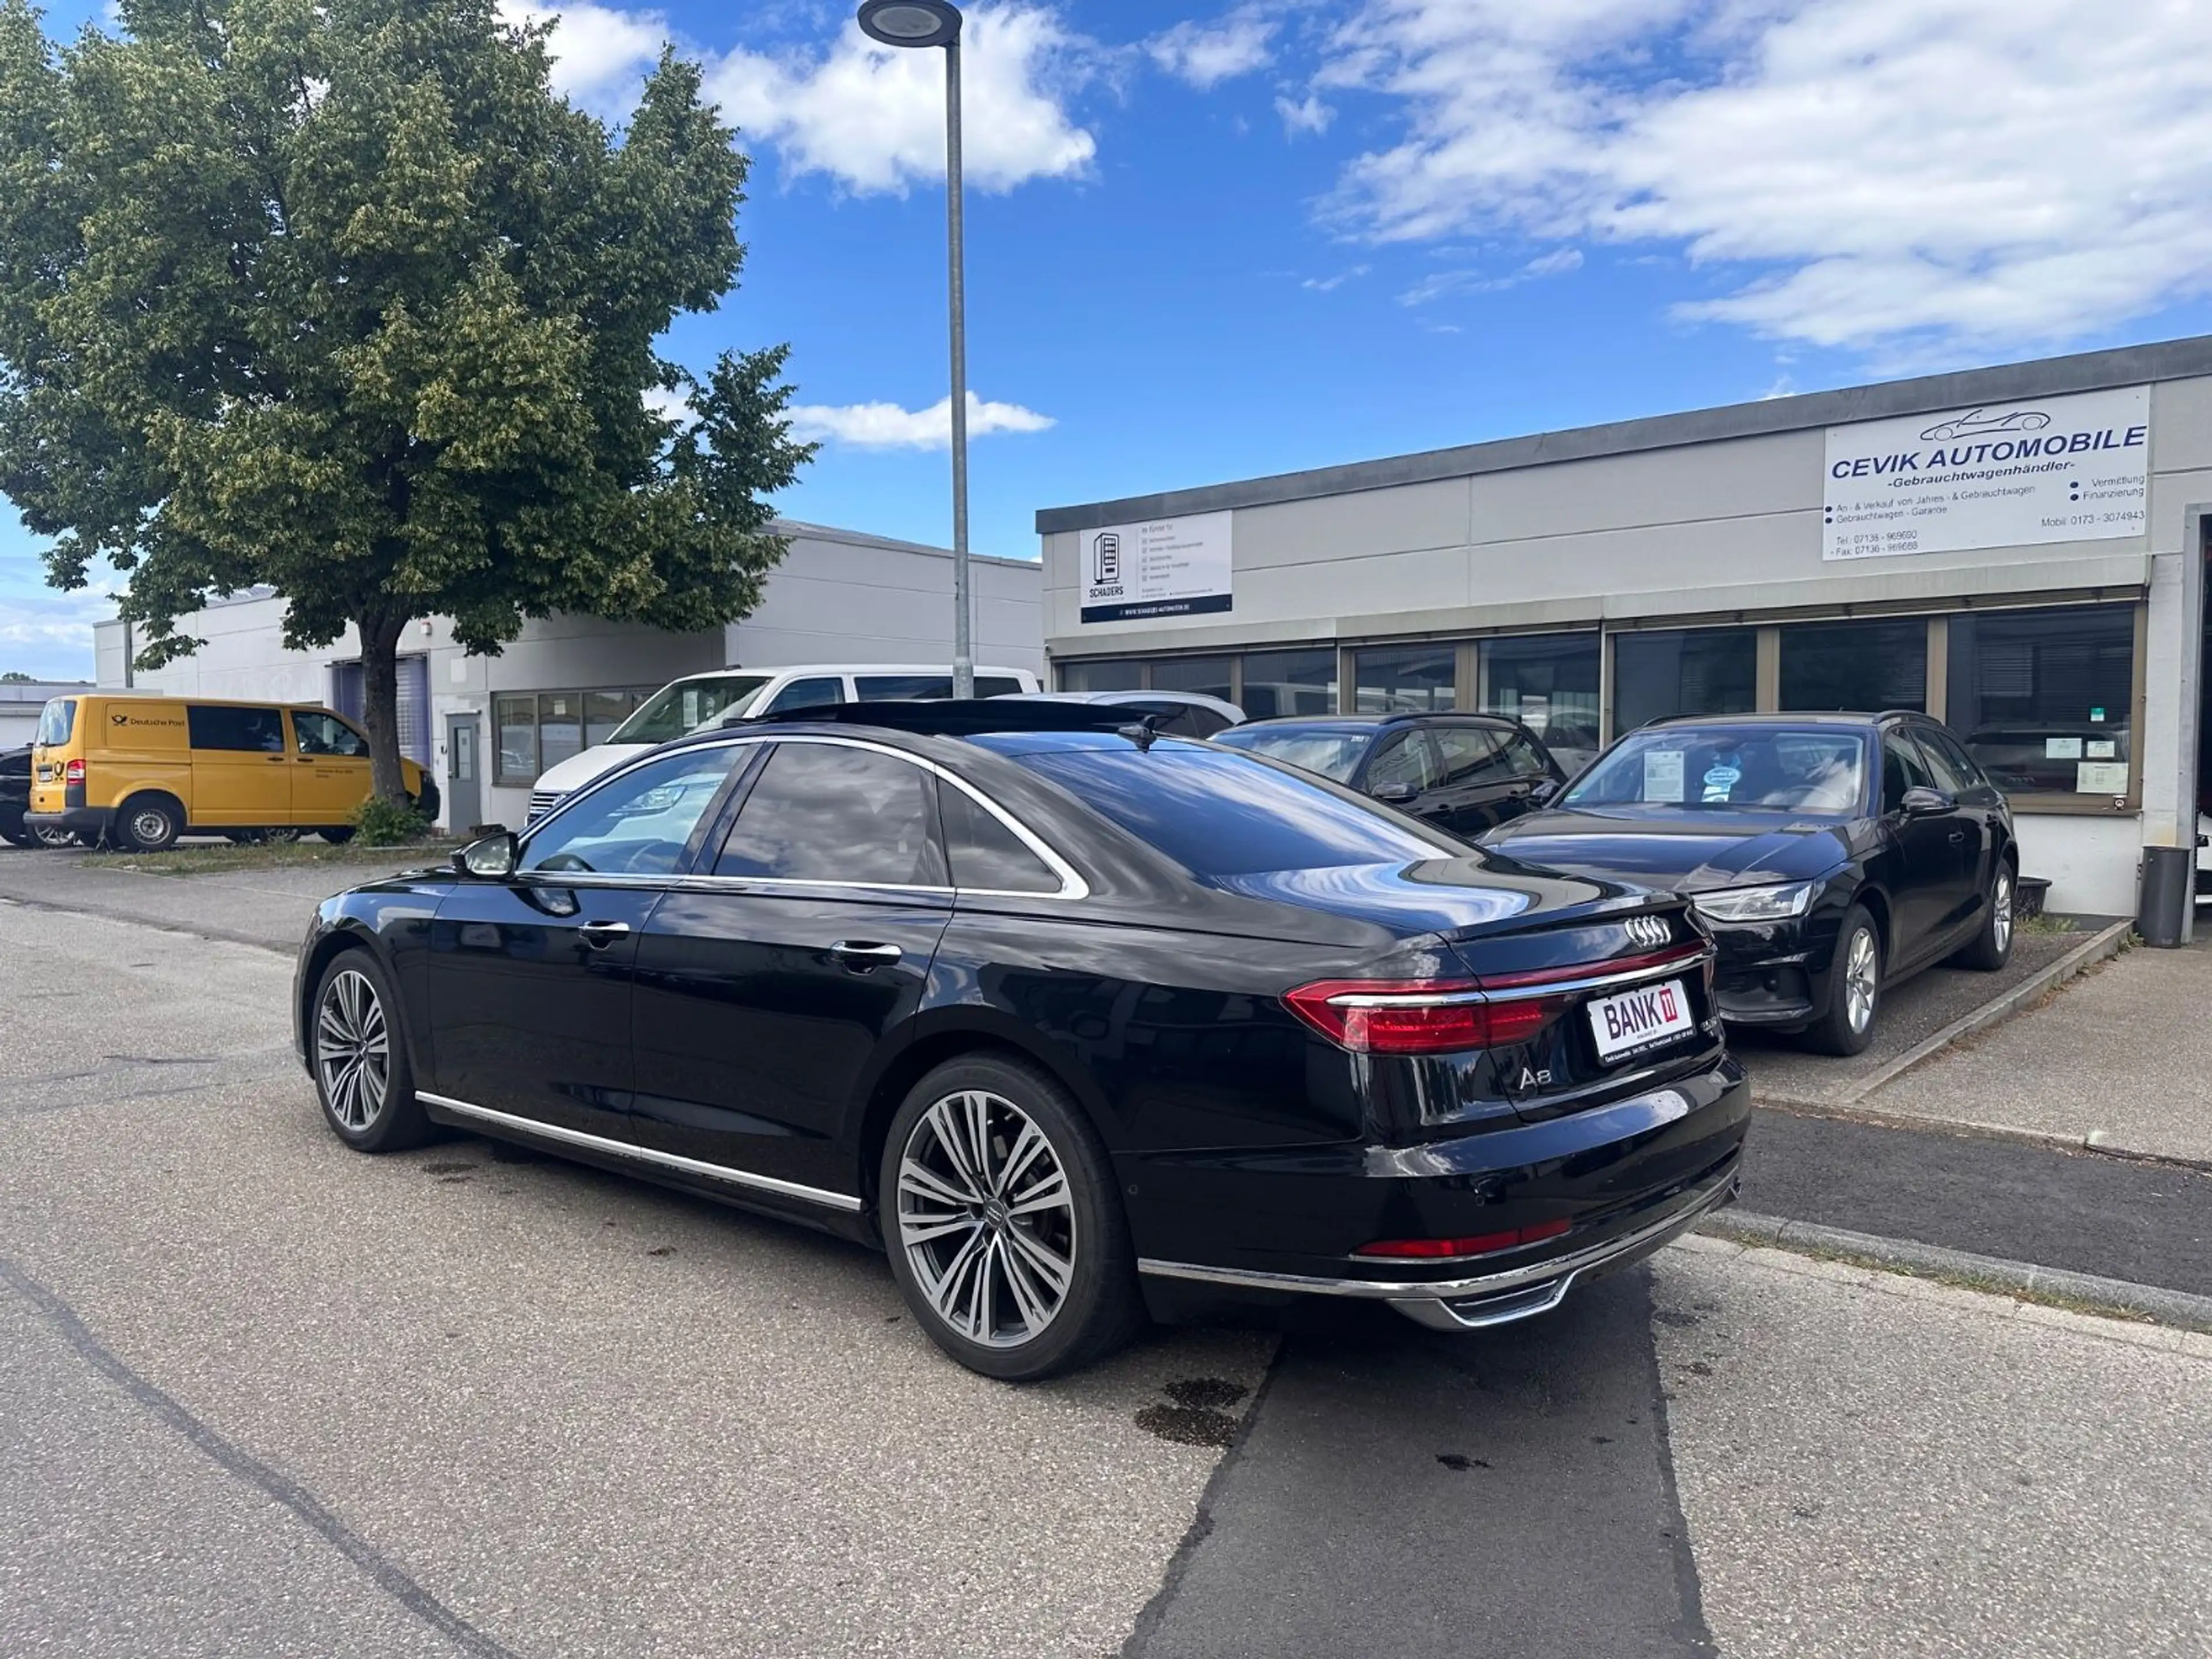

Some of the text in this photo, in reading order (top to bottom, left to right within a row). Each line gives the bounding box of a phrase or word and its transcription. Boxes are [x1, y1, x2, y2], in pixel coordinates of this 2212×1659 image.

[1832, 425, 2147, 479] CEVIK AUTOMOBILE
[2092, 475, 2145, 487] Vermittlung
[2083, 488, 2145, 500] Finanzierung
[2071, 514, 2094, 525] 0173
[1603, 992, 1662, 1040] BANK
[1519, 1067, 1551, 1090] A8
